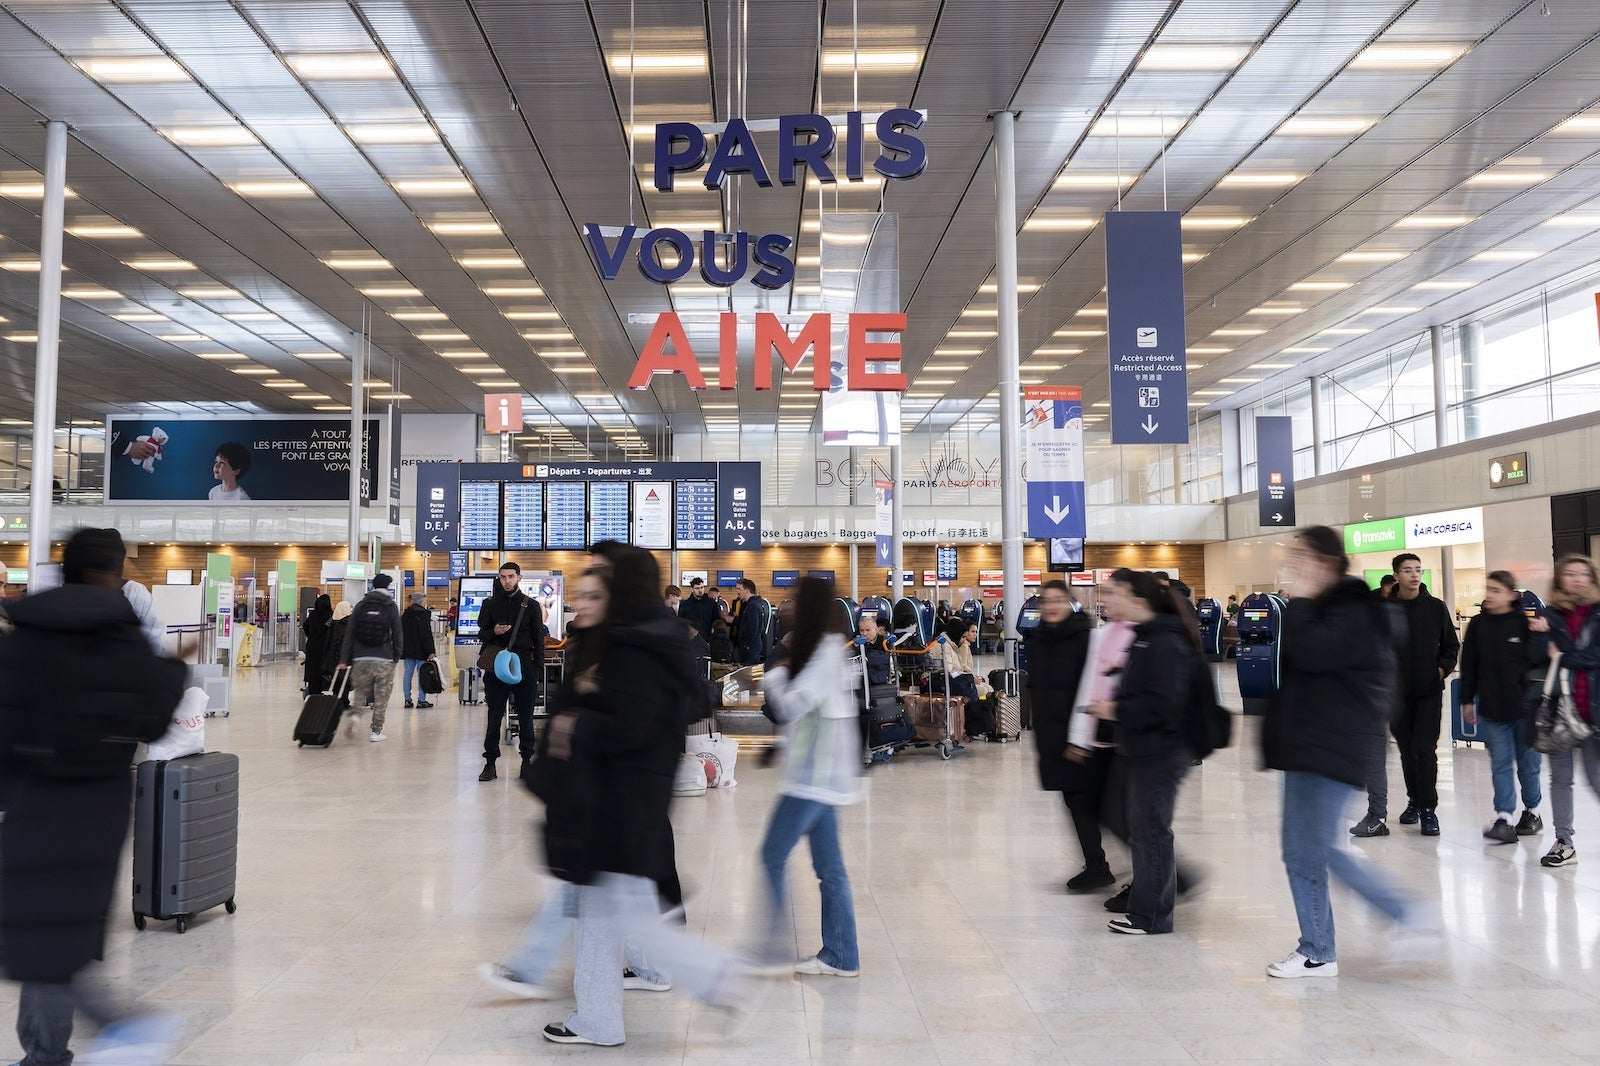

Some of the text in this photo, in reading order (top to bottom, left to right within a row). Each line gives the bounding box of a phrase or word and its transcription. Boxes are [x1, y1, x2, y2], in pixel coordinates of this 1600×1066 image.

[654, 108, 928, 192] PARIS
[584, 223, 795, 290] VOUS
[627, 312, 907, 392] AIME
[311, 428, 320, 438] À
[322, 430, 346, 438] TOUT
[254, 441, 270, 450] LES
[272, 441, 308, 450] PETITES
[282, 452, 308, 460] FONT
[309, 452, 326, 460] LES
[550, 468, 580, 477] Départs
[588, 468, 631, 477] Departures
[1508, 470, 1524, 478] ROLEX
[361, 477, 370, 499] 33
[424, 522, 449, 531] D,E,F
[725, 520, 755, 530] A,B,C
[1418, 522, 1472, 535] AIR CORSICA
[784, 529, 828, 539] bagages
[947, 528, 988, 538] 行李托运
[1361, 528, 1396, 542] transavia
